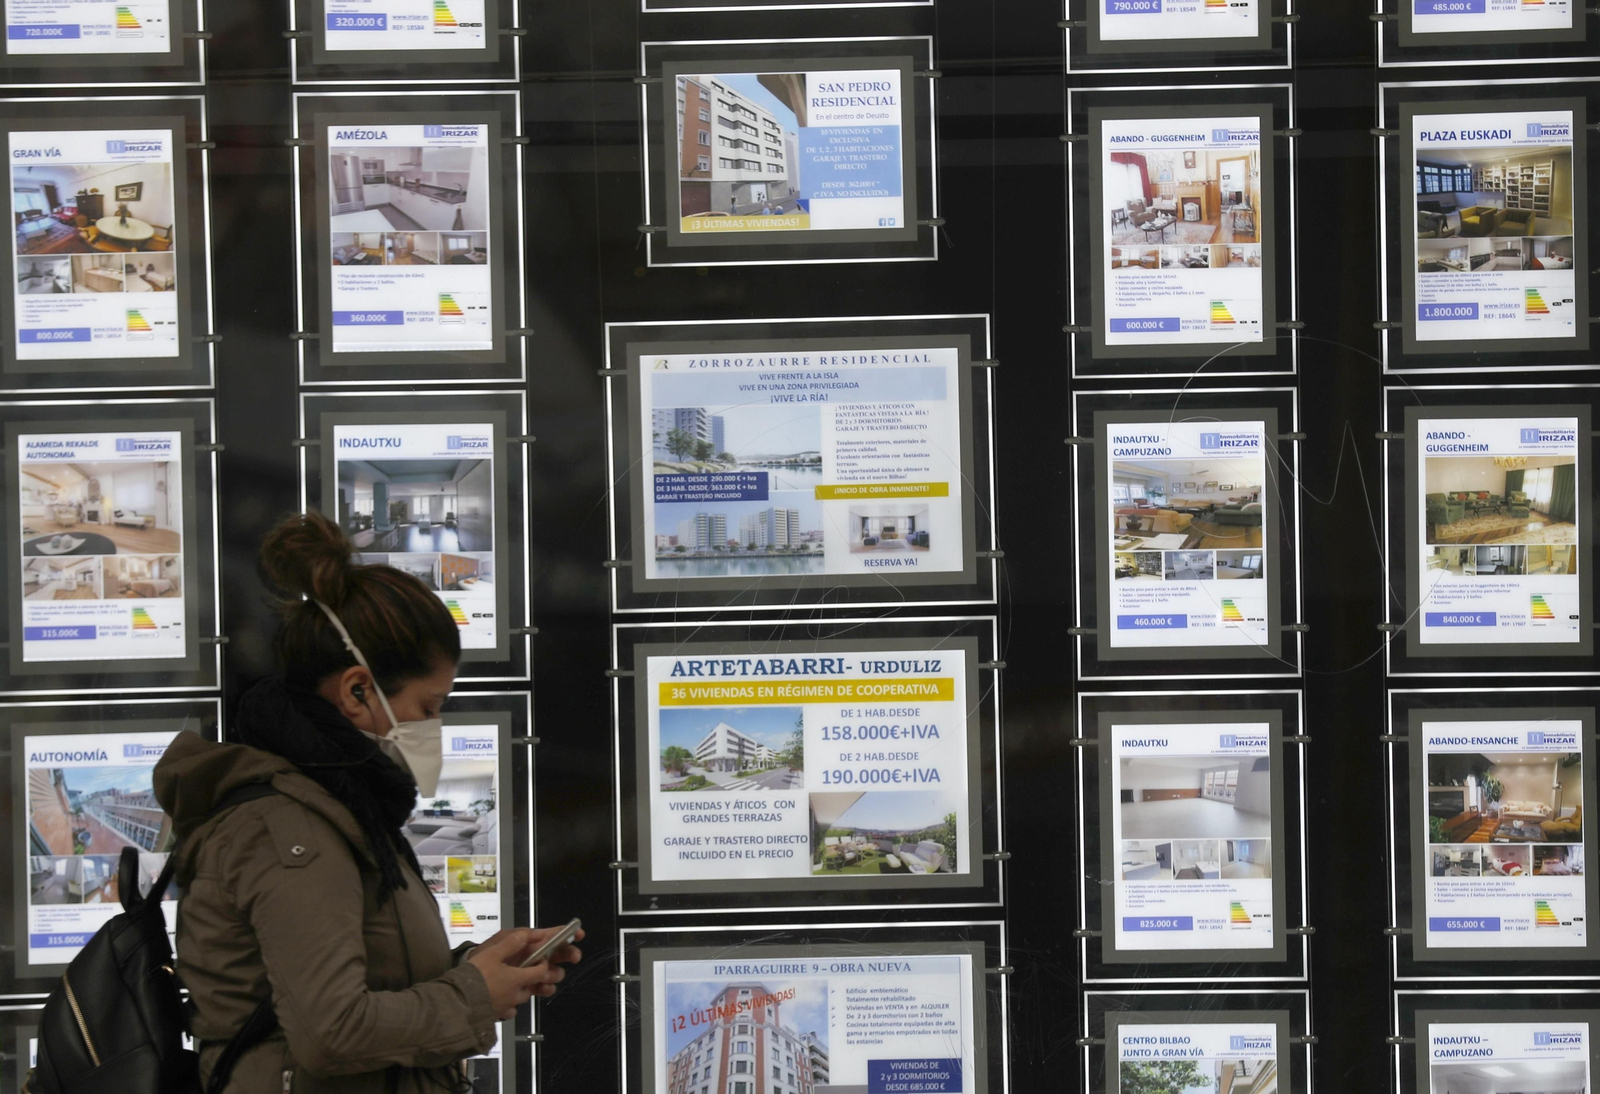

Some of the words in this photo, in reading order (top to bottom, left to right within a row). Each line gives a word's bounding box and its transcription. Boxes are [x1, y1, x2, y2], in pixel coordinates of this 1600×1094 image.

[1114, 2, 1150, 10] 790.000
[336, 18, 375, 26] 320.000
[819, 83, 844, 92] SAN
[848, 82, 891, 92] PEDRO
[812, 96, 896, 107] RESIDENCIAL
[336, 129, 388, 140] AMÉZOLA
[1420, 131, 1457, 141] PLAZA
[1460, 130, 1511, 140] EUSKADI
[1540, 128, 1569, 136] IRIZAR
[1227, 134, 1260, 142] IRIZAR
[13, 150, 42, 158] GRAN
[44, 147, 62, 157] VÍA
[692, 220, 701, 231] ¡3
[703, 220, 744, 231] ÚLTIMAS
[746, 218, 800, 229] VIVIENDAS!
[1425, 307, 1473, 316] 1.800.000
[689, 358, 810, 368] ZORROZAURRE
[820, 355, 930, 365] RESIDENCIAL
[770, 394, 794, 403] ¡VIVE
[810, 392, 828, 401] RÍA!
[339, 438, 401, 448] INDAUTXU
[1538, 434, 1574, 442] IRIZAR
[1219, 439, 1258, 448] IRIZAR
[834, 485, 858, 494] ¡INICIO
[858, 485, 867, 493] DE
[869, 485, 888, 493] OBRA
[864, 559, 902, 567] RESERVA
[860, 660, 942, 673] URDULIZ
[672, 688, 687, 699] 36
[689, 687, 755, 698] VIVIENDAS
[757, 687, 774, 697] EN
[777, 685, 834, 697] RÉGIMEN
[837, 685, 853, 696] DE
[856, 684, 939, 695] COOPERATIVA
[841, 709, 853, 718] DE
[857, 709, 862, 718] 1
[30, 750, 108, 762] AUTONOMÍA
[840, 753, 852, 762] DE
[856, 753, 861, 761] 2
[669, 802, 722, 810] VIVIENDAS
[724, 802, 731, 810] Y
[733, 800, 767, 810] ÁTICOS
[774, 800, 795, 809] CON
[682, 814, 730, 823] GRANDES
[732, 813, 782, 822] TERRAZAS
[664, 837, 701, 846] GARAJE
[704, 837, 711, 845] Y
[713, 836, 764, 845] TRASTERO
[766, 834, 809, 844] DIRECTO
[679, 851, 727, 860] INCLUIDO
[729, 850, 742, 859] EN
[745, 850, 756, 859] EL
[758, 849, 794, 858] PRECIO
[48, 936, 85, 944] 315.000€
[714, 964, 807, 975] IPARRAGUIRRE
[812, 964, 819, 972] 9
[830, 964, 865, 972] OBRA
[868, 963, 911, 972] NUEVA
[671, 1014, 686, 1034] ¡2
[690, 1000, 744, 1026] ÚLTIMAS
[745, 987, 796, 1012] VIVIENDAS!
[1434, 1036, 1480, 1045] INDAUTXU
[1189, 1048, 1204, 1056] VÍA
[1434, 1049, 1493, 1057] CAMPUZANO
